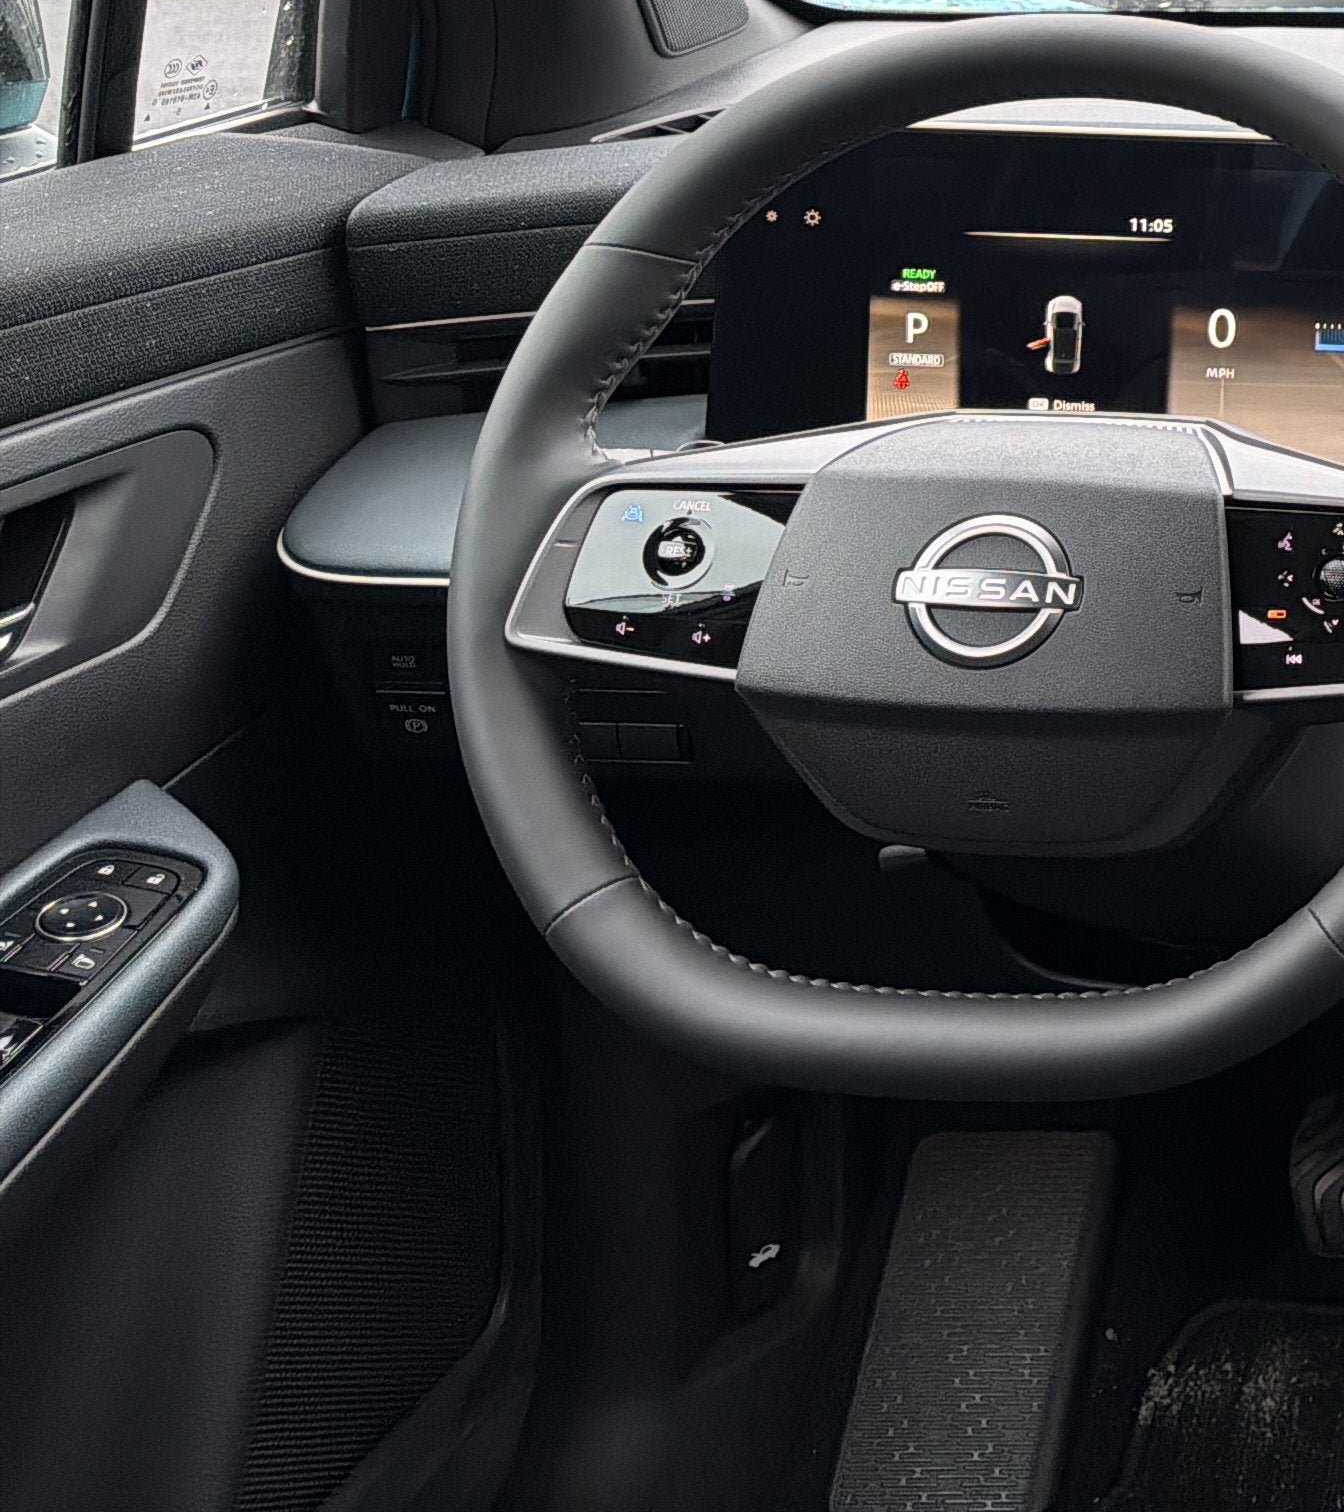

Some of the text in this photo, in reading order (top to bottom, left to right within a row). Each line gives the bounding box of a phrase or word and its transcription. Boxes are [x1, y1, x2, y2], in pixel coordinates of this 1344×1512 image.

[1129, 217, 1173, 234] 11:05
[902, 268, 936, 280] READY
[905, 312, 930, 344] P
[1207, 308, 1237, 349] 0
[891, 354, 942, 366] STANDARD
[1205, 367, 1236, 380] MPH
[1054, 400, 1096, 412] Dismiss
[673, 500, 712, 512] CANCEL
[901, 575, 1077, 606] NISSAN
[661, 593, 683, 604] SET
